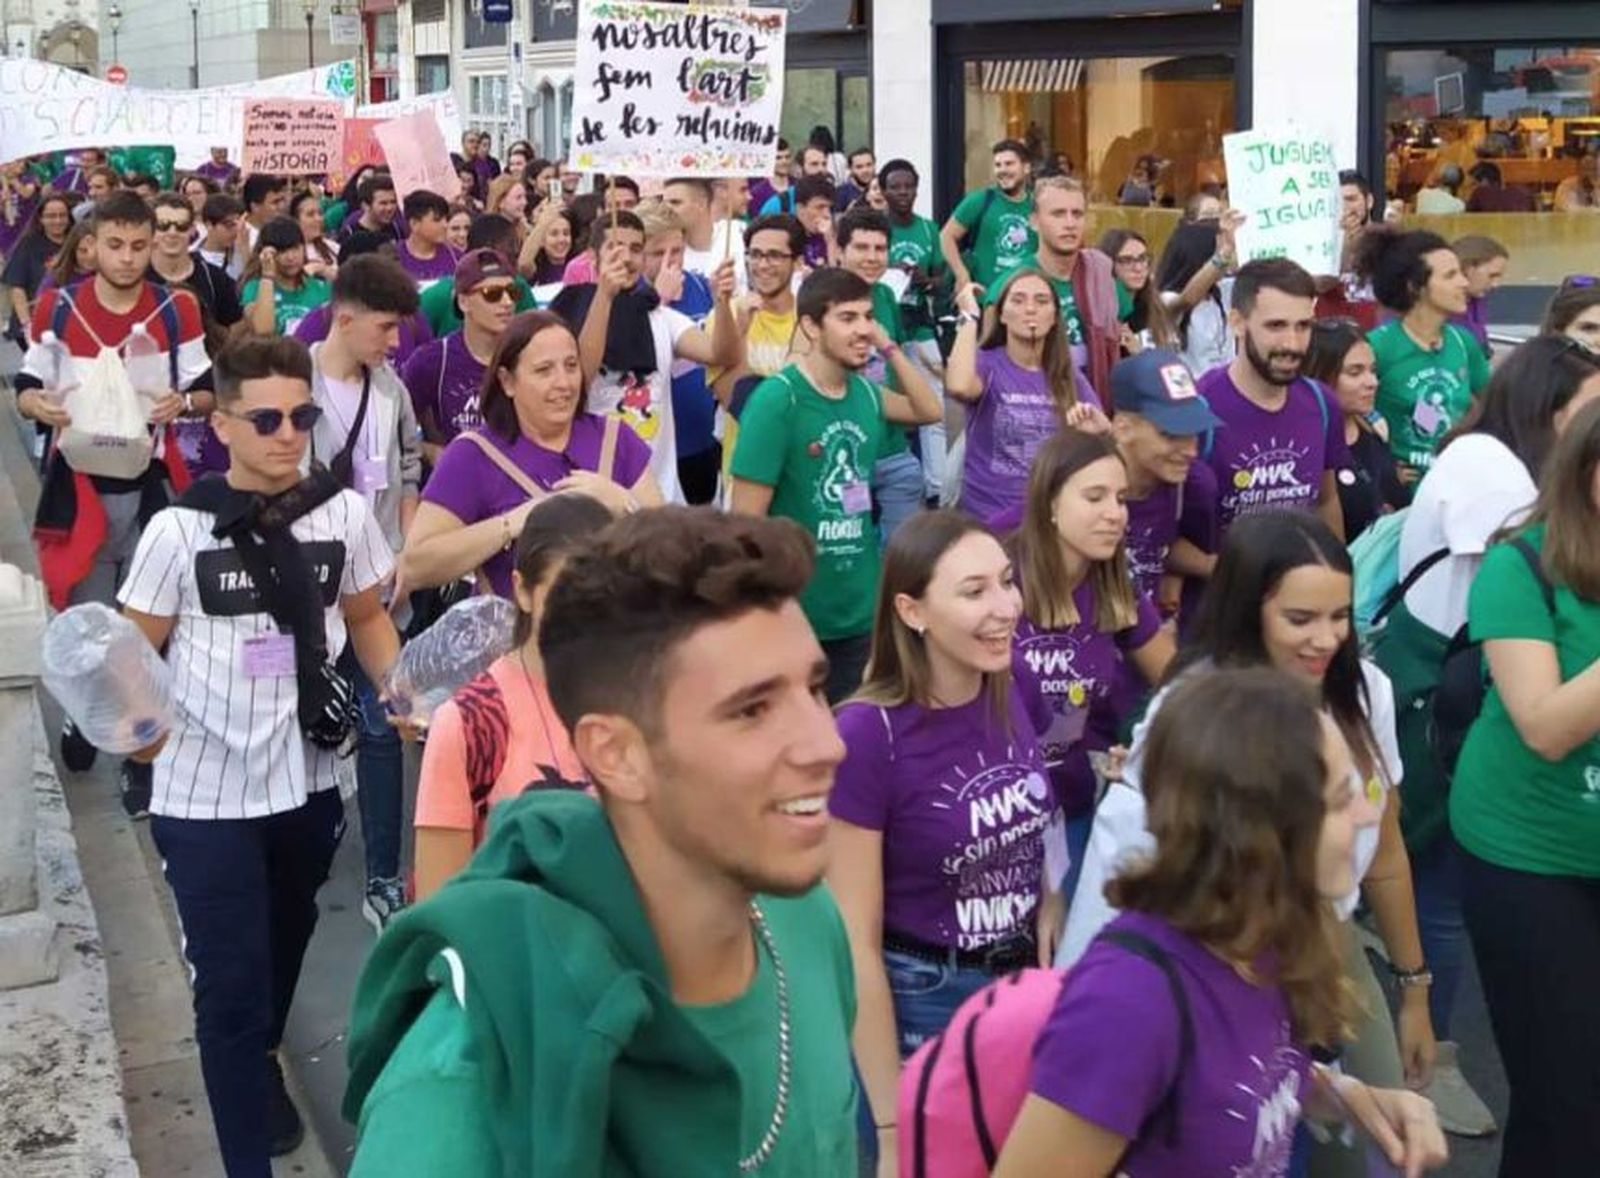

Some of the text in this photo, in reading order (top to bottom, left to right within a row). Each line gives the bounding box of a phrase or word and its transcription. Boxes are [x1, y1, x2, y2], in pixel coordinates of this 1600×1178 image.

[592, 14, 767, 61] nosaltres
[593, 61, 652, 103] fem
[576, 116, 607, 146] de
[619, 102, 662, 139] les
